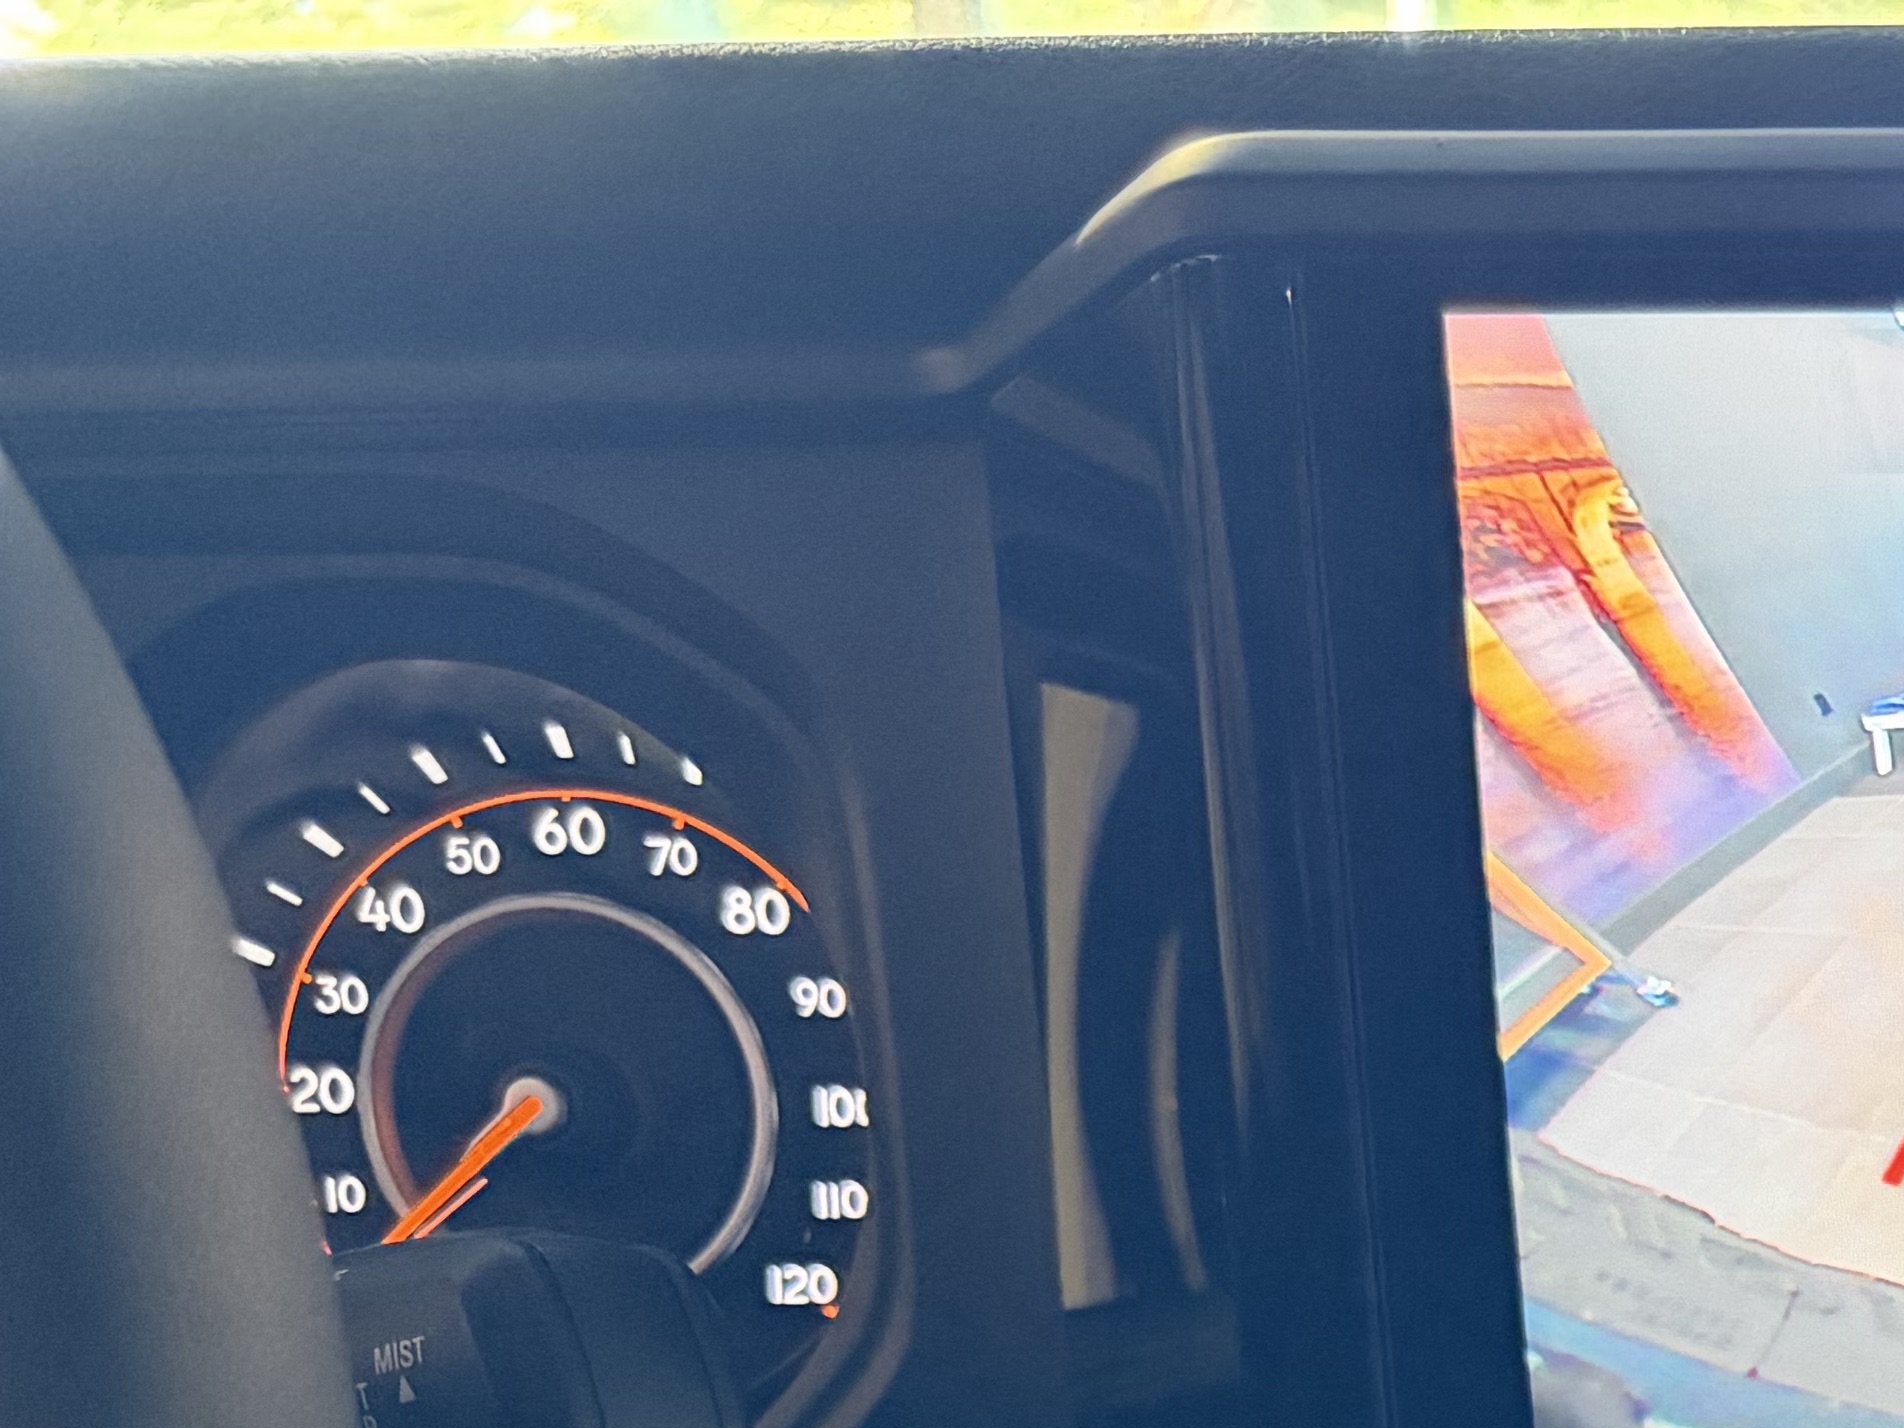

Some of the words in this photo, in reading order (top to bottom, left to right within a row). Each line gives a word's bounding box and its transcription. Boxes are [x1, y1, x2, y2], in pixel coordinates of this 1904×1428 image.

[532, 806, 606, 856] 60
[445, 836, 501, 875] 50
[643, 836, 699, 876] 70
[358, 885, 426, 934] 40
[719, 887, 791, 936] 80
[313, 975, 369, 1014] 30
[789, 976, 847, 1018] 90
[290, 1067, 355, 1114] 20
[323, 1175, 366, 1213] 10
[811, 1179, 869, 1220] 110
[765, 1263, 839, 1305] 120
[373, 1336, 425, 1375] MIST
